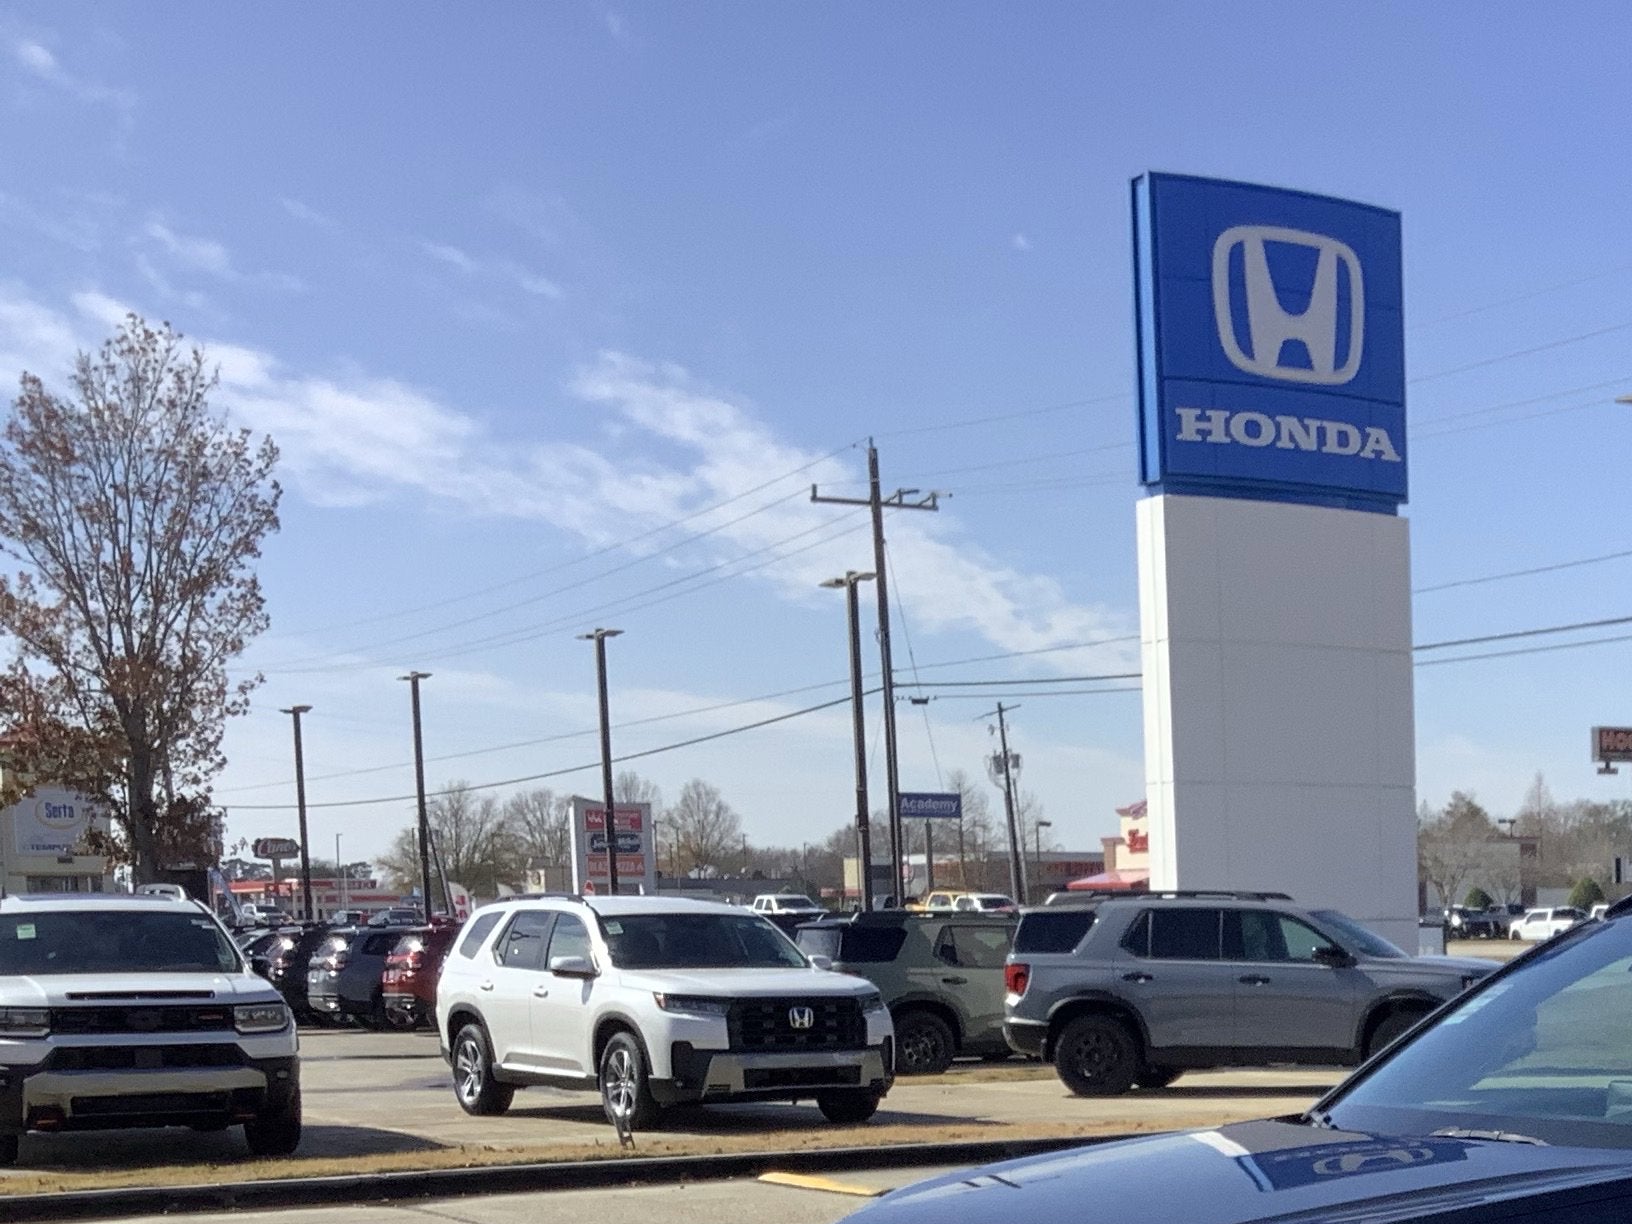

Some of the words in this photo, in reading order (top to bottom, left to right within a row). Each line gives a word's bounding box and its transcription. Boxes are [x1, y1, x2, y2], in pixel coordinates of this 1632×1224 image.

[1175, 407, 1401, 463] HONDA
[44, 802, 75, 818] Serta
[901, 797, 958, 812] Academy
